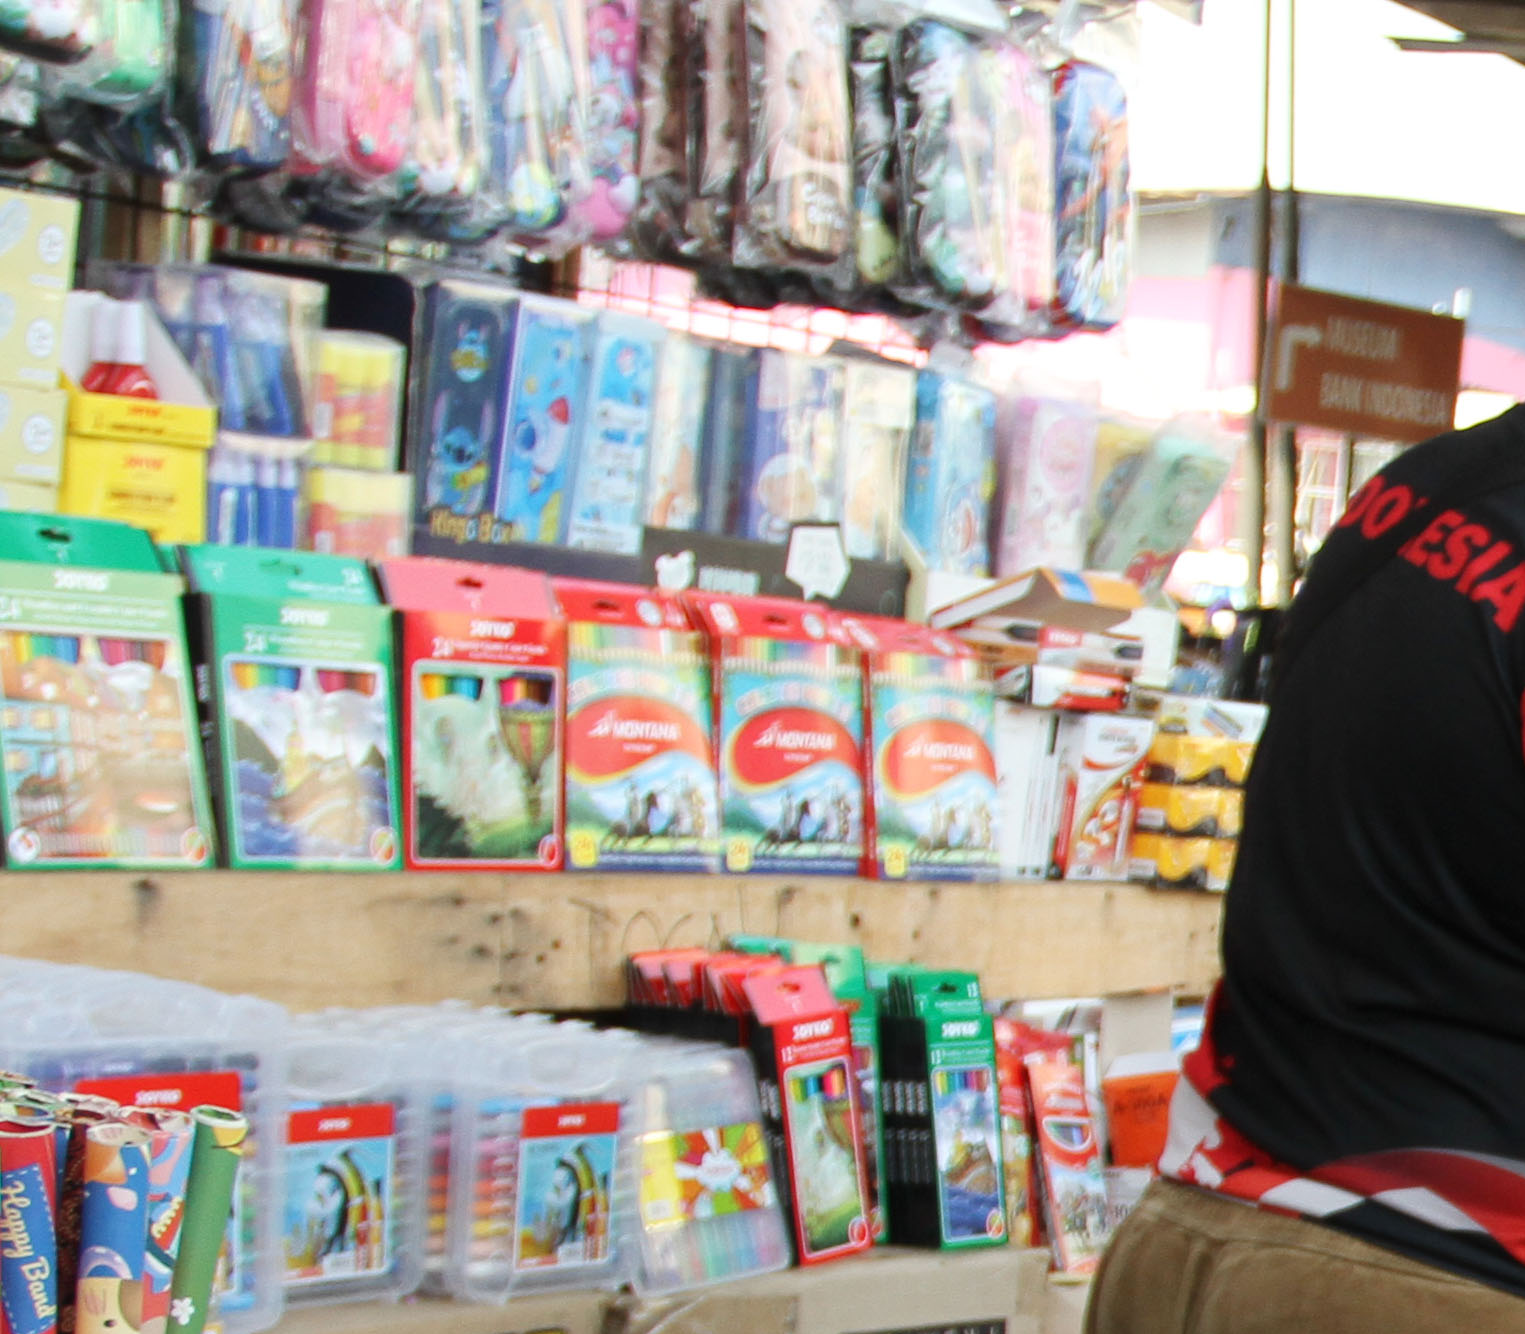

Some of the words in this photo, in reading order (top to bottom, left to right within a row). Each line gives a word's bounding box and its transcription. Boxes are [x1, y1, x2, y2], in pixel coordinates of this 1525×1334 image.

[1326, 314, 1399, 362] MUSEUM
[1319, 371, 1363, 413] BANK
[1364, 378, 1449, 427] INDONESIA
[612, 720, 682, 742] MONTANA
[775, 729, 838, 751] MONTANA
[921, 741, 977, 761] MONTANA
[20, 1254, 57, 1320] Band
